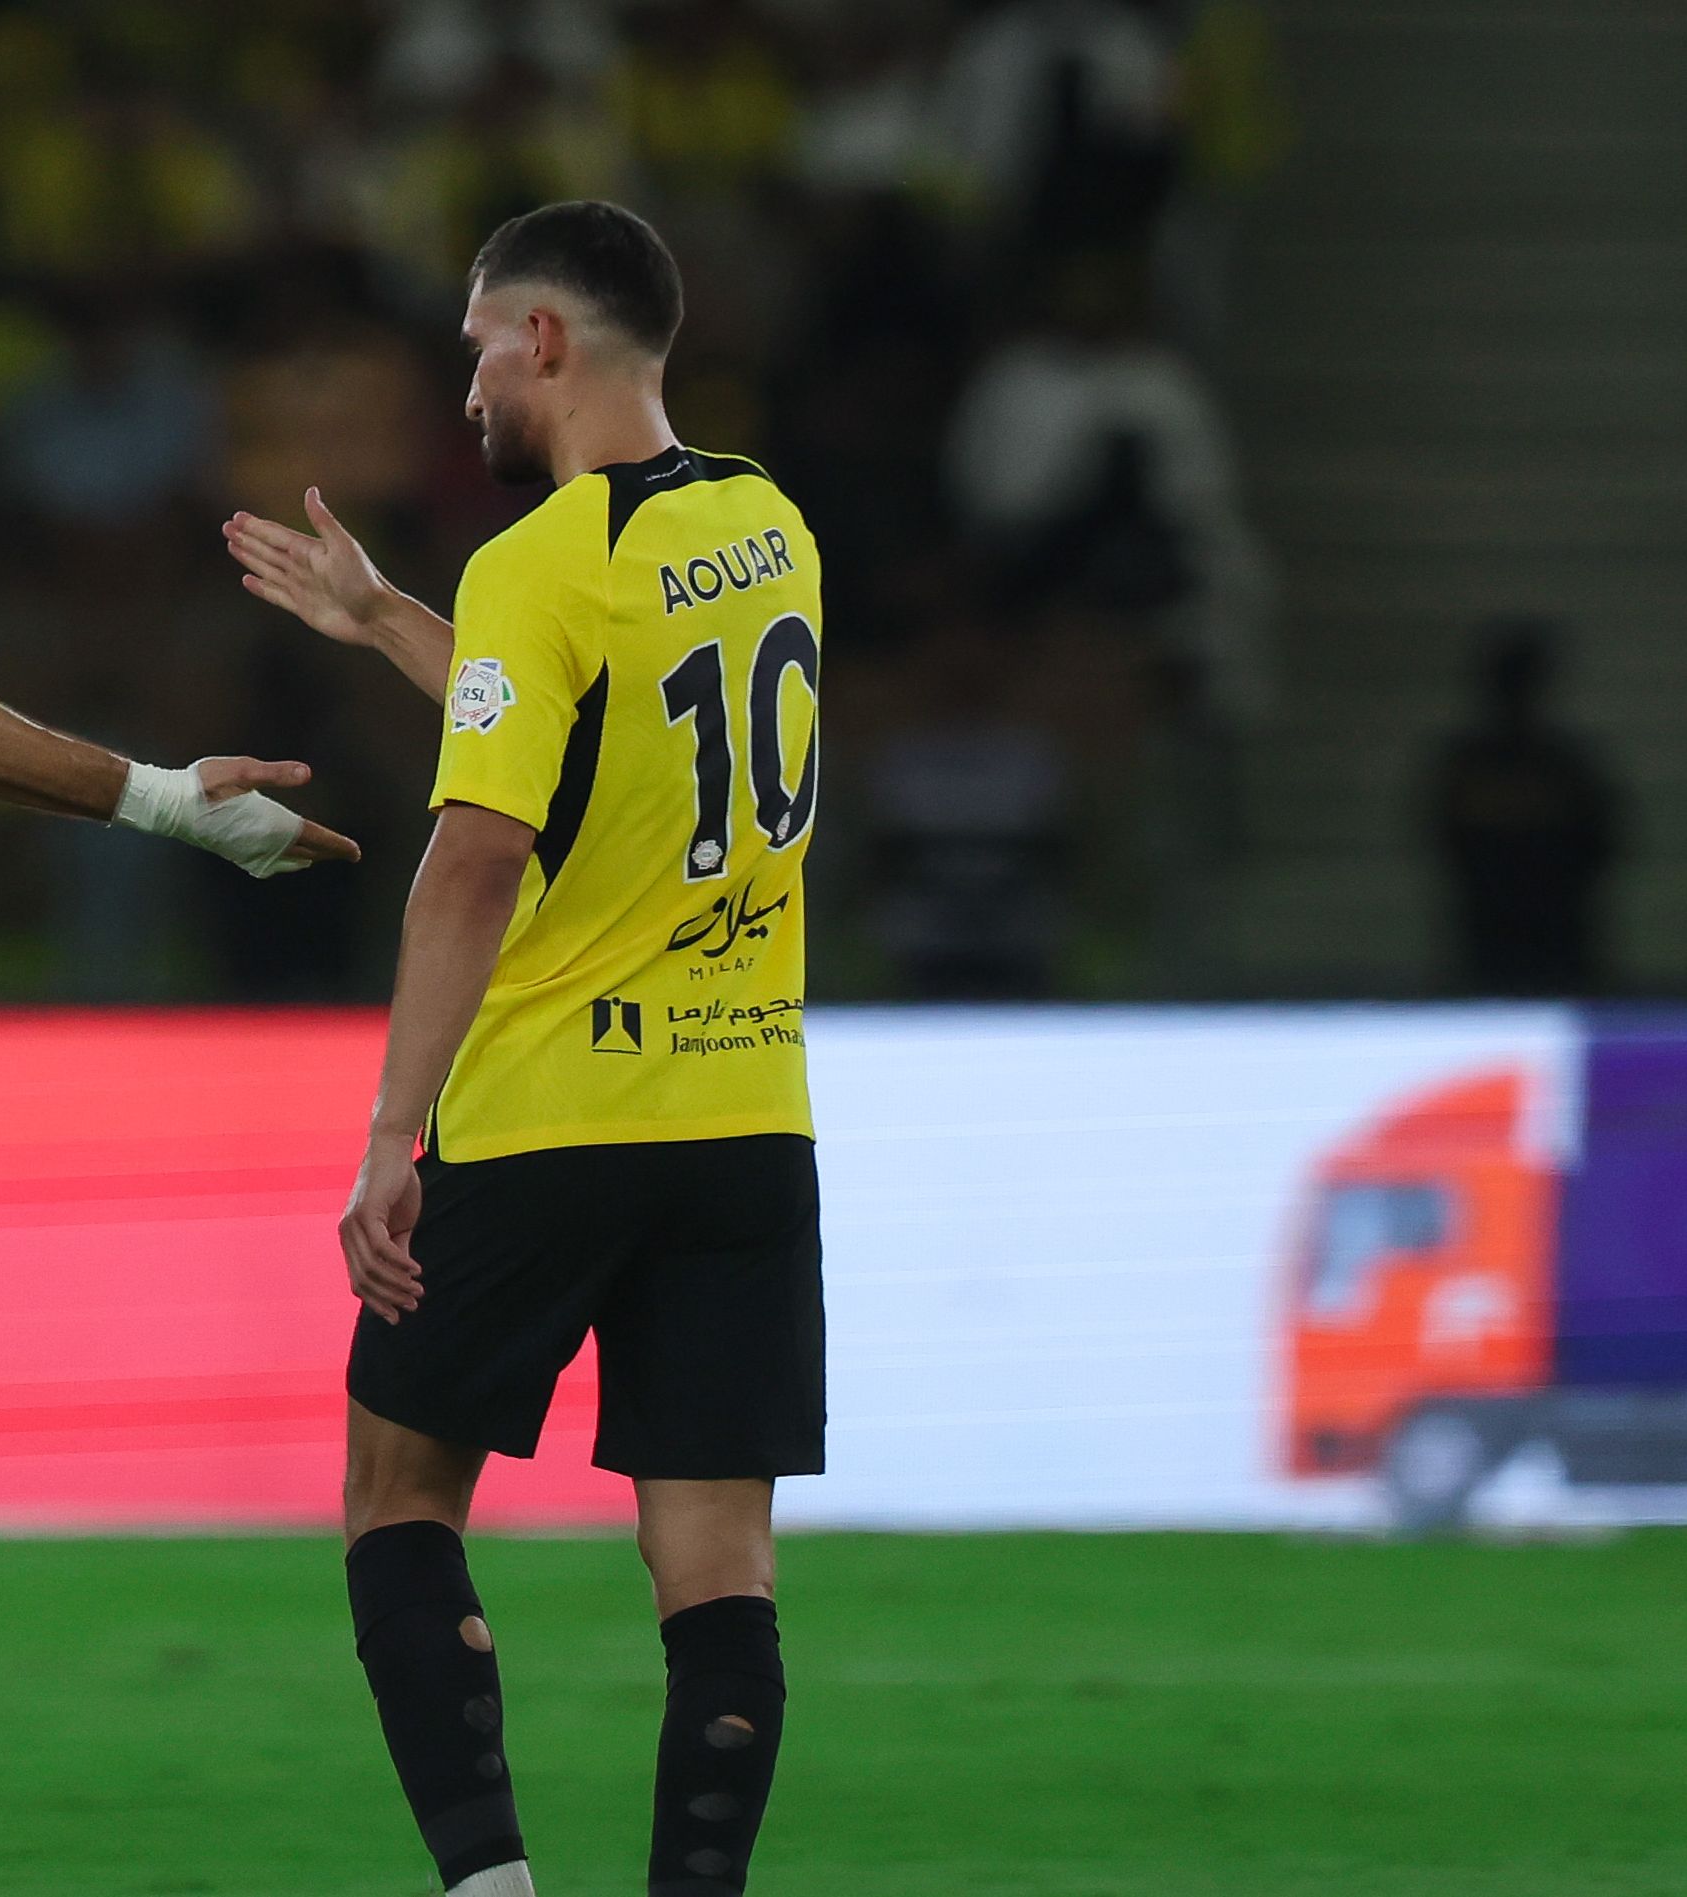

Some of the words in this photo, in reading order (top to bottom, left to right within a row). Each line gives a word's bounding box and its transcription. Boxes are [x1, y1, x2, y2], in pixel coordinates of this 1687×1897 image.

[659, 527, 795, 616] AOUAR
[462, 687, 486, 703] RSL
[658, 611, 821, 884] 10
